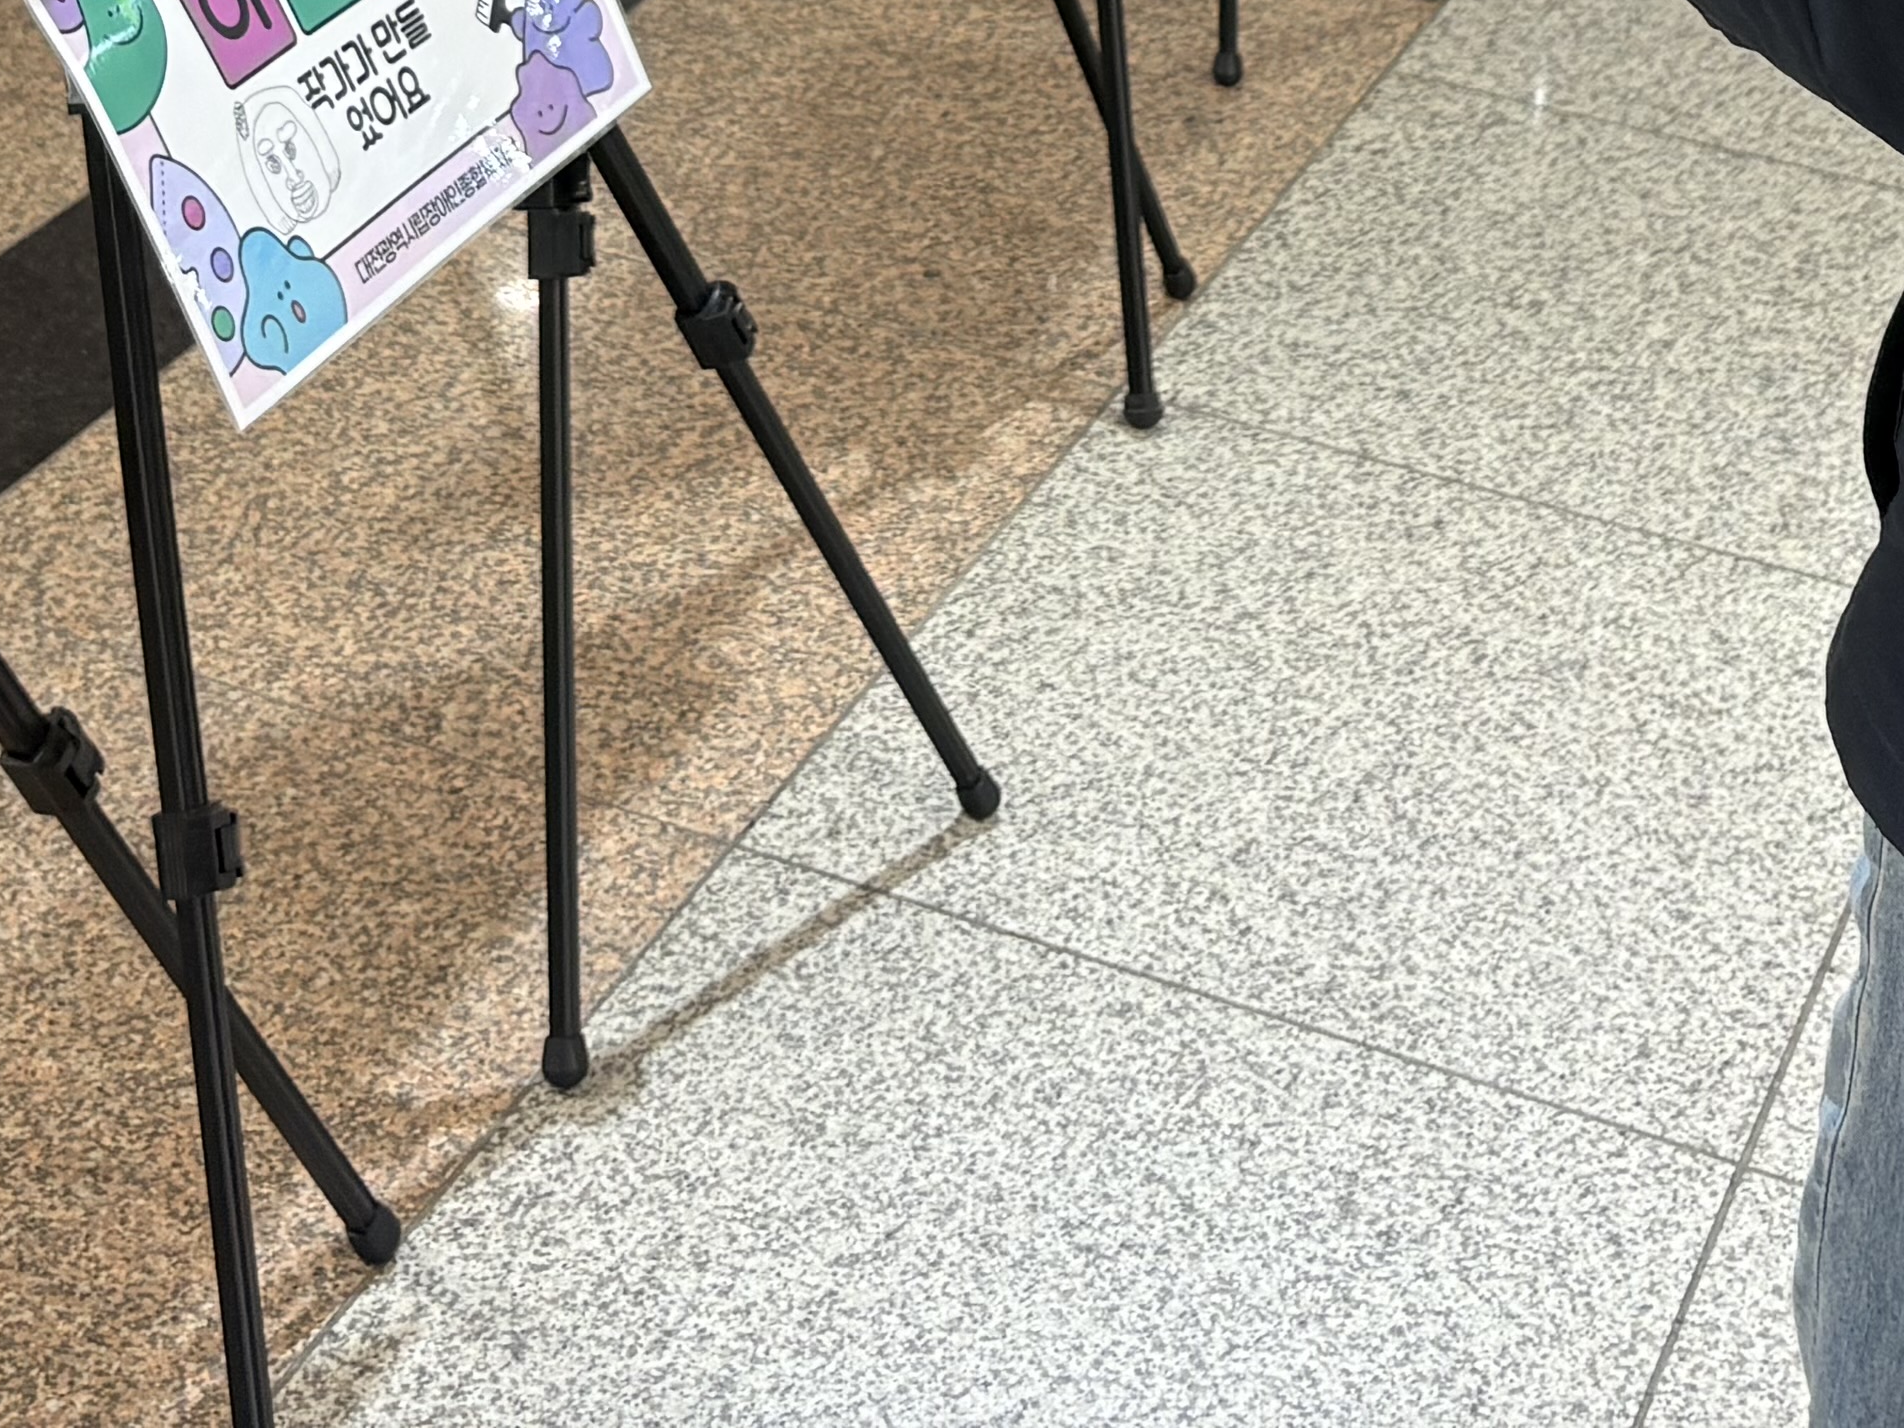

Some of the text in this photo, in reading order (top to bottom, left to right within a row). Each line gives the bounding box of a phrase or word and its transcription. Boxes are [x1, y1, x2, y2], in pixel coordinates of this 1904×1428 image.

[297, 33, 379, 111] 작가가
[346, 66, 432, 151] 었어요
[354, 134, 520, 285] 대전광역시립장애인종합
